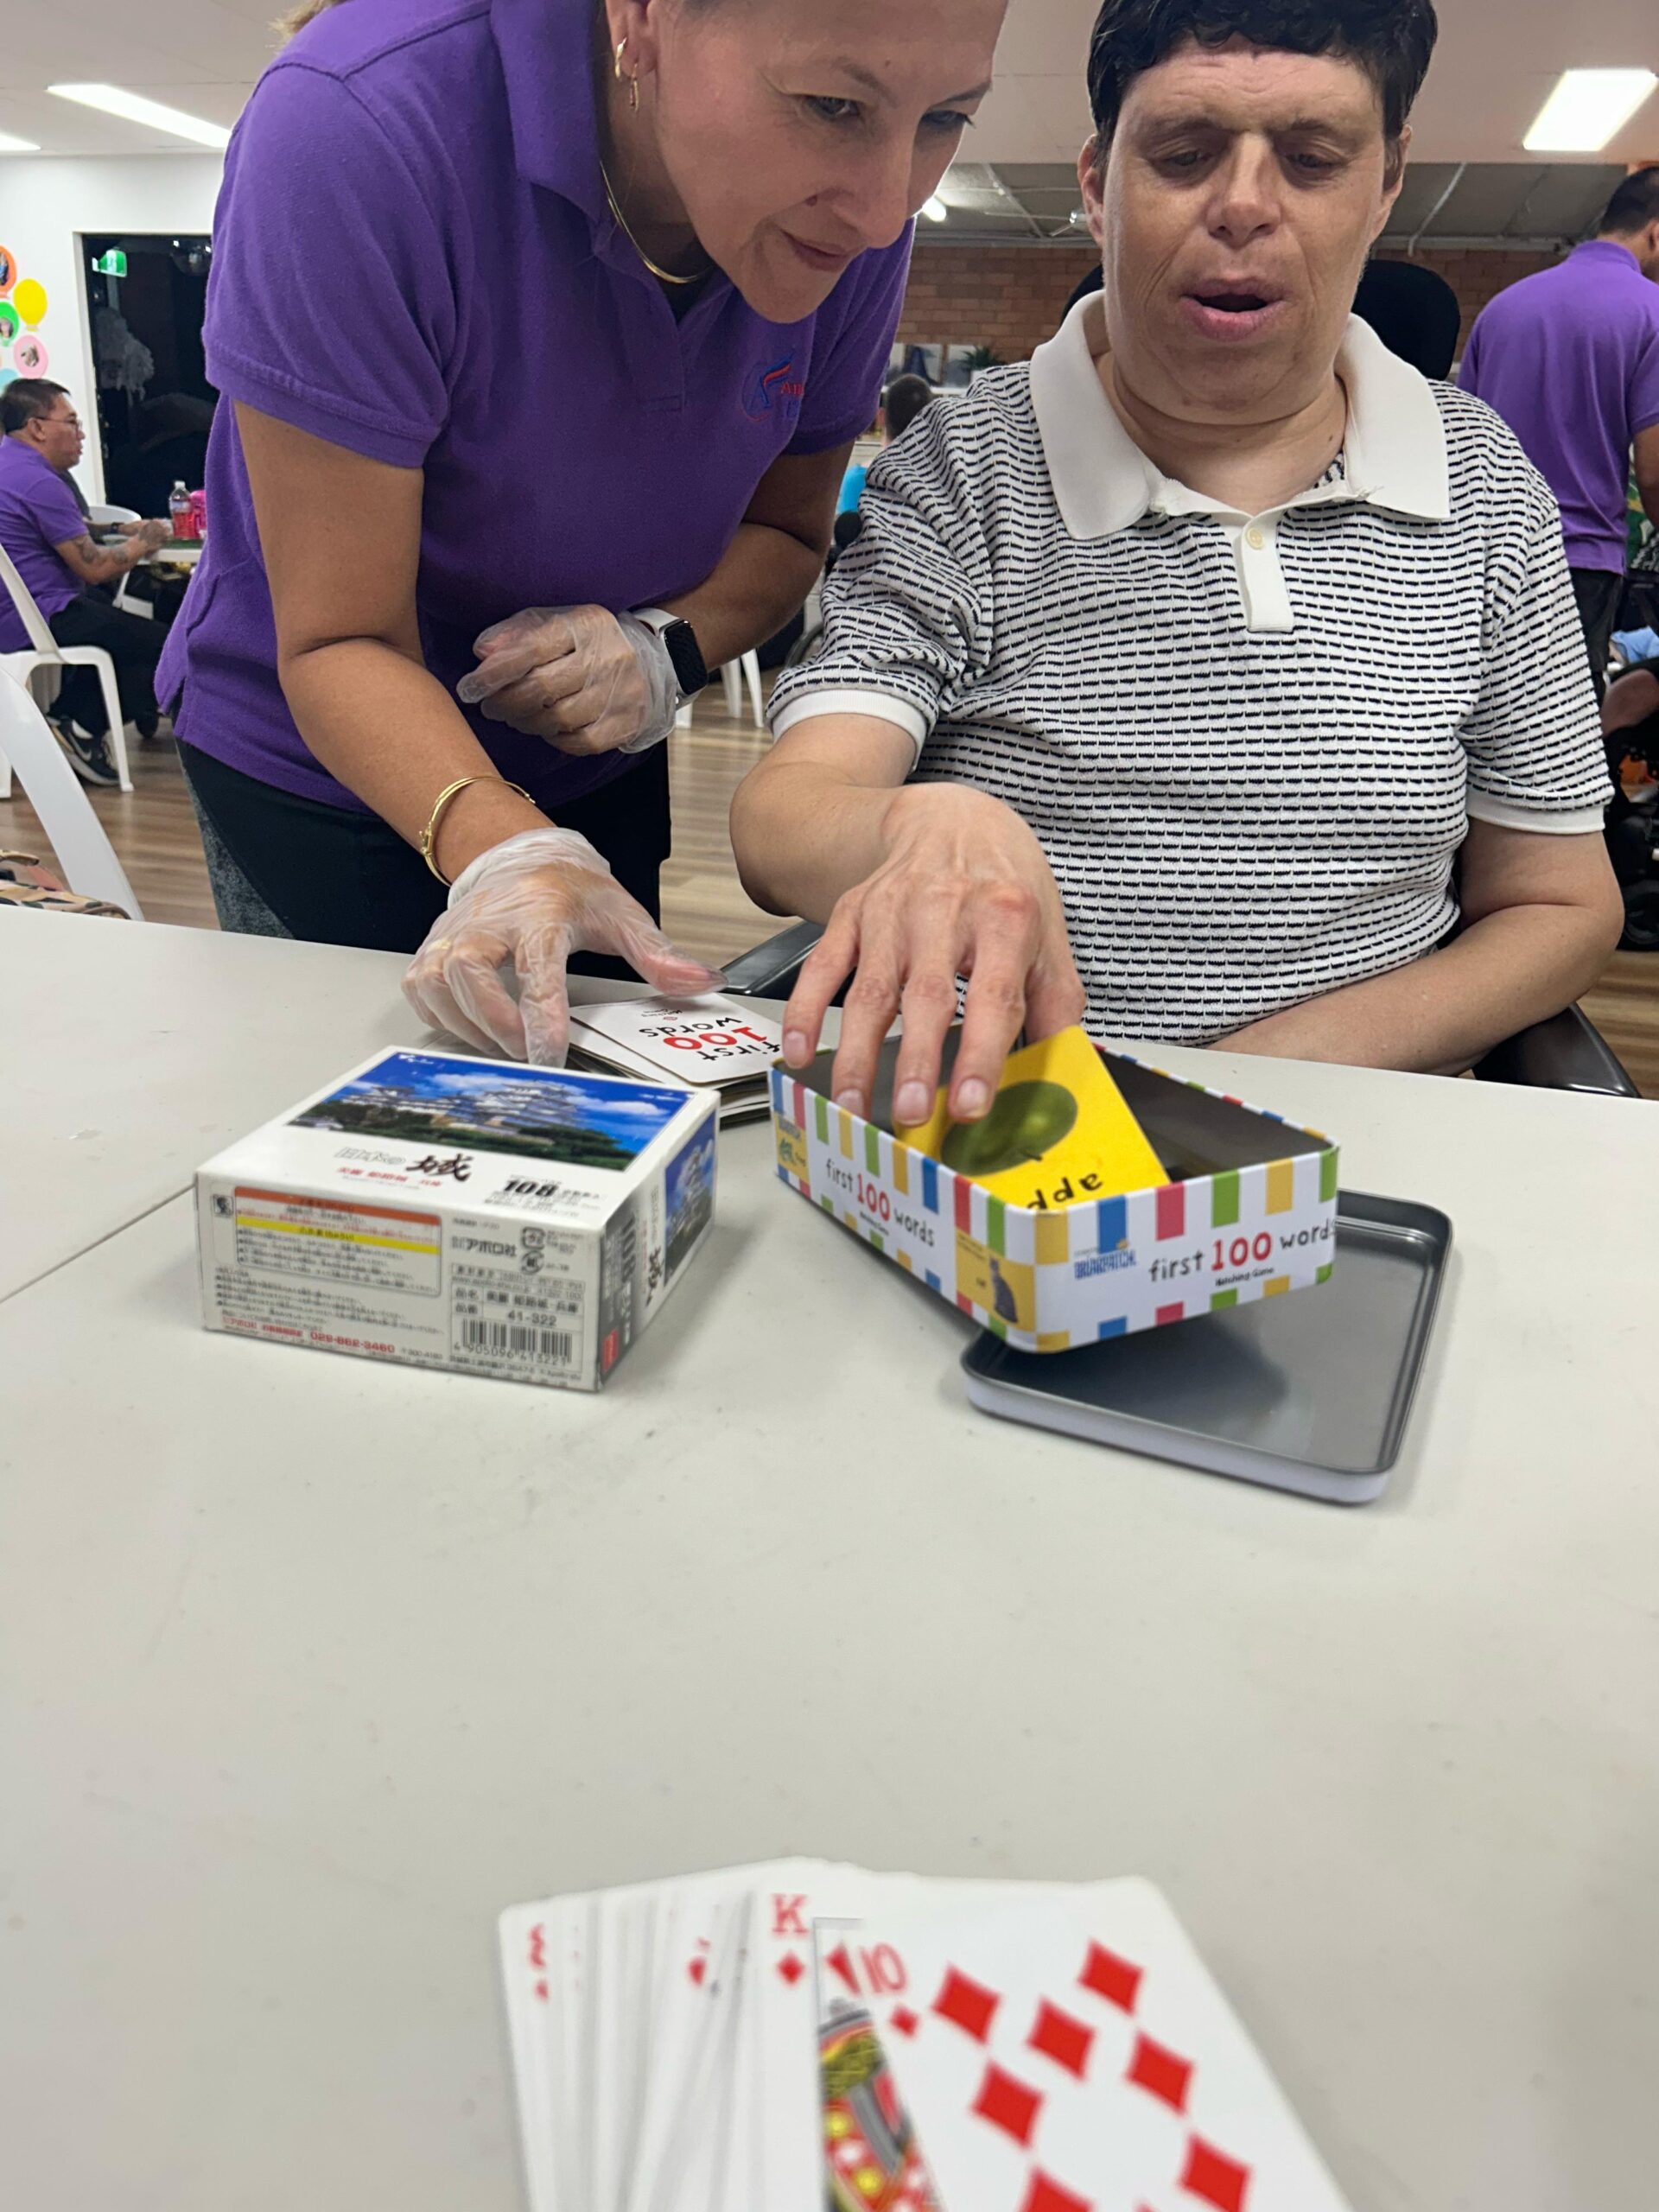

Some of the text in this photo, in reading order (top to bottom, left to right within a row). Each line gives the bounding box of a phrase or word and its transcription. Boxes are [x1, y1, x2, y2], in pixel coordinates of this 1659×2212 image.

[639, 1017, 743, 1037] words
[663, 1027, 767, 1050] 100
[696, 1041, 780, 1061] first
[406, 1153, 473, 1181] 城
[503, 1178, 561, 1198] 108
[825, 1158, 854, 1193] first
[856, 1173, 891, 1222] 100
[893, 1207, 935, 1247] words
[1148, 1217, 1335, 1282] first 100 word
[1216, 1267, 1274, 1287] Matching Game
[507, 1310, 557, 1327] 41-322
[467, 1343, 514, 1360] 905096
[771, 1893, 809, 1935] K
[859, 1942, 908, 1994] 10
